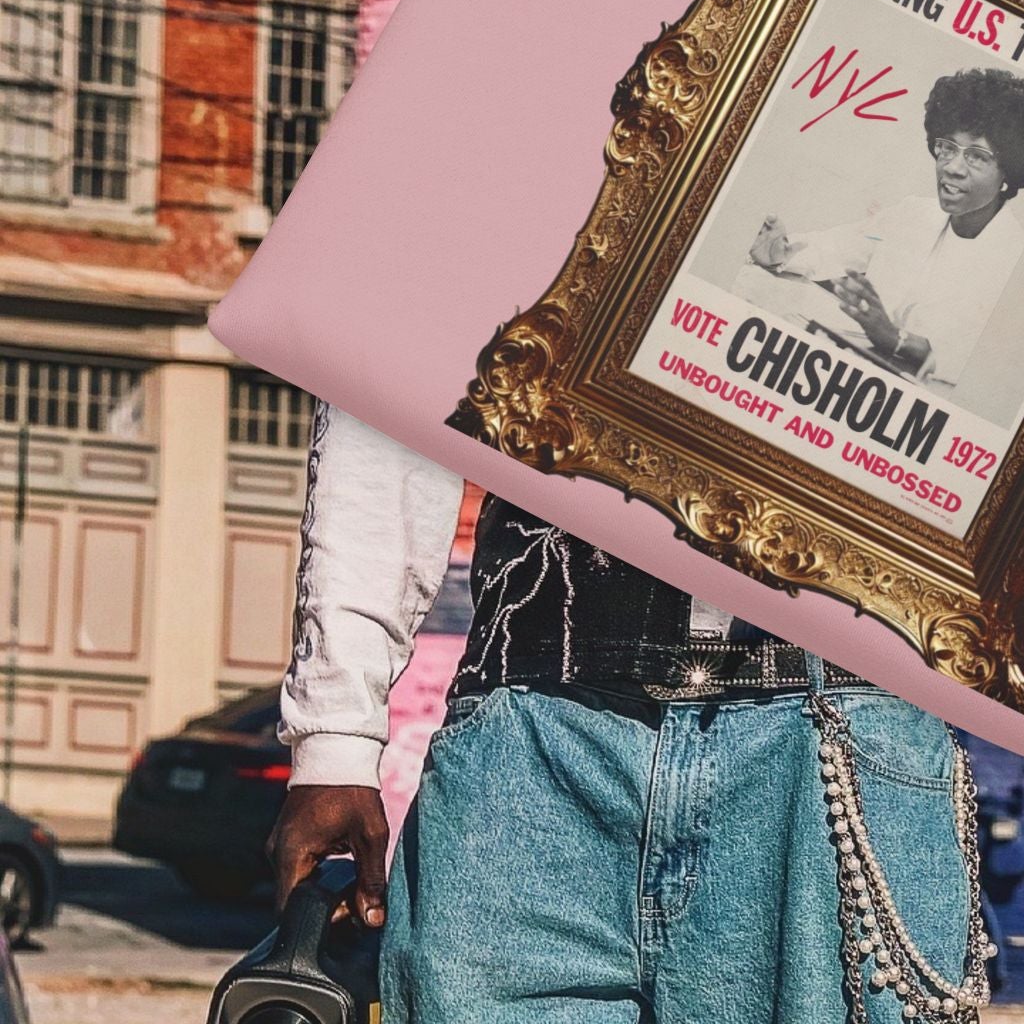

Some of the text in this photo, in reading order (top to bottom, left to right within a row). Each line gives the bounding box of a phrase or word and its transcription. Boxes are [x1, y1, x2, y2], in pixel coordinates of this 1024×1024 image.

[791, 45, 908, 132] NYC
[658, 351, 784, 424] UNBOUGHT
[784, 415, 834, 449] AND
[841, 441, 963, 514] UNBOSSED
[671, 298, 997, 481] VOTE CHISHOLM 1972
